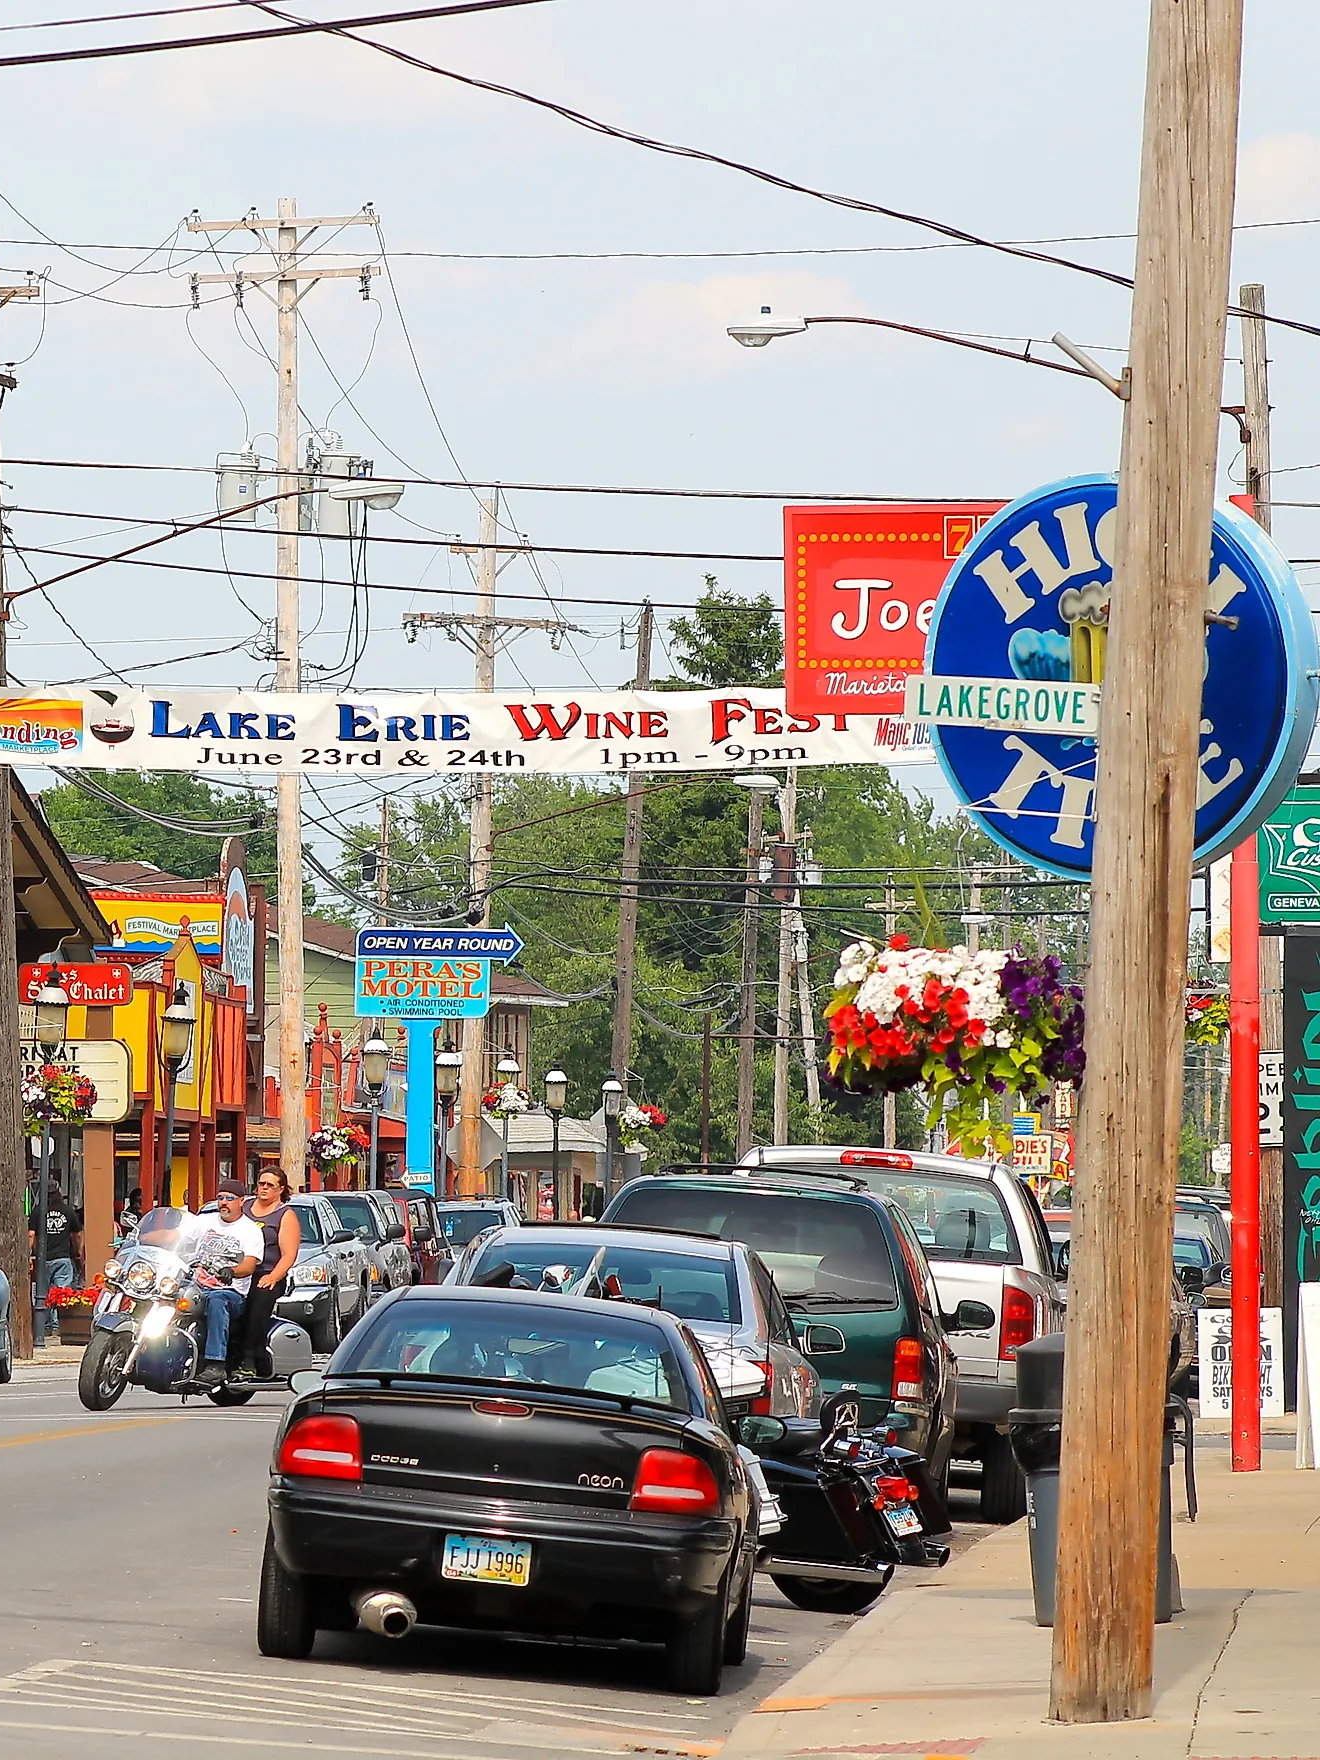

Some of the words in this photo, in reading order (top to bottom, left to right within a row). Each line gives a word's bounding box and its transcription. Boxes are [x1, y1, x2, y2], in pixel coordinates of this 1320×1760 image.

[917, 683, 1086, 725] LAKEGROVE
[148, 699, 297, 742] LAKE
[336, 703, 471, 742] ERIE
[504, 701, 669, 741] WINE
[197, 746, 283, 766] June
[301, 748, 381, 767] 23rd
[397, 750, 428, 767] &
[447, 749, 526, 767] 24th
[599, 747, 680, 769] 1pm
[724, 744, 809, 768] 9pm
[127, 920, 161, 933] FESTIVAL
[162, 923, 216, 937] MARTPLACE
[364, 937, 408, 950] OPEN
[412, 938, 453, 950] YEAR
[458, 938, 514, 951] ROUND
[362, 960, 482, 980] PERA'S
[27, 968, 78, 1000] Sss
[69, 980, 125, 1001] Chalet
[360, 980, 483, 999] MOTEL
[387, 999, 401, 1007] AIR
[405, 999, 465, 1008] CONDITIONED
[388, 1007, 434, 1016] SWIMMING
[438, 1008, 463, 1017] POOL
[403, 1174, 429, 1182] PATIO
[1211, 1345, 1272, 1361] ON
[577, 1473, 624, 1489] neon
[449, 1546, 481, 1570] FJJ
[485, 1550, 525, 1575] 1996
